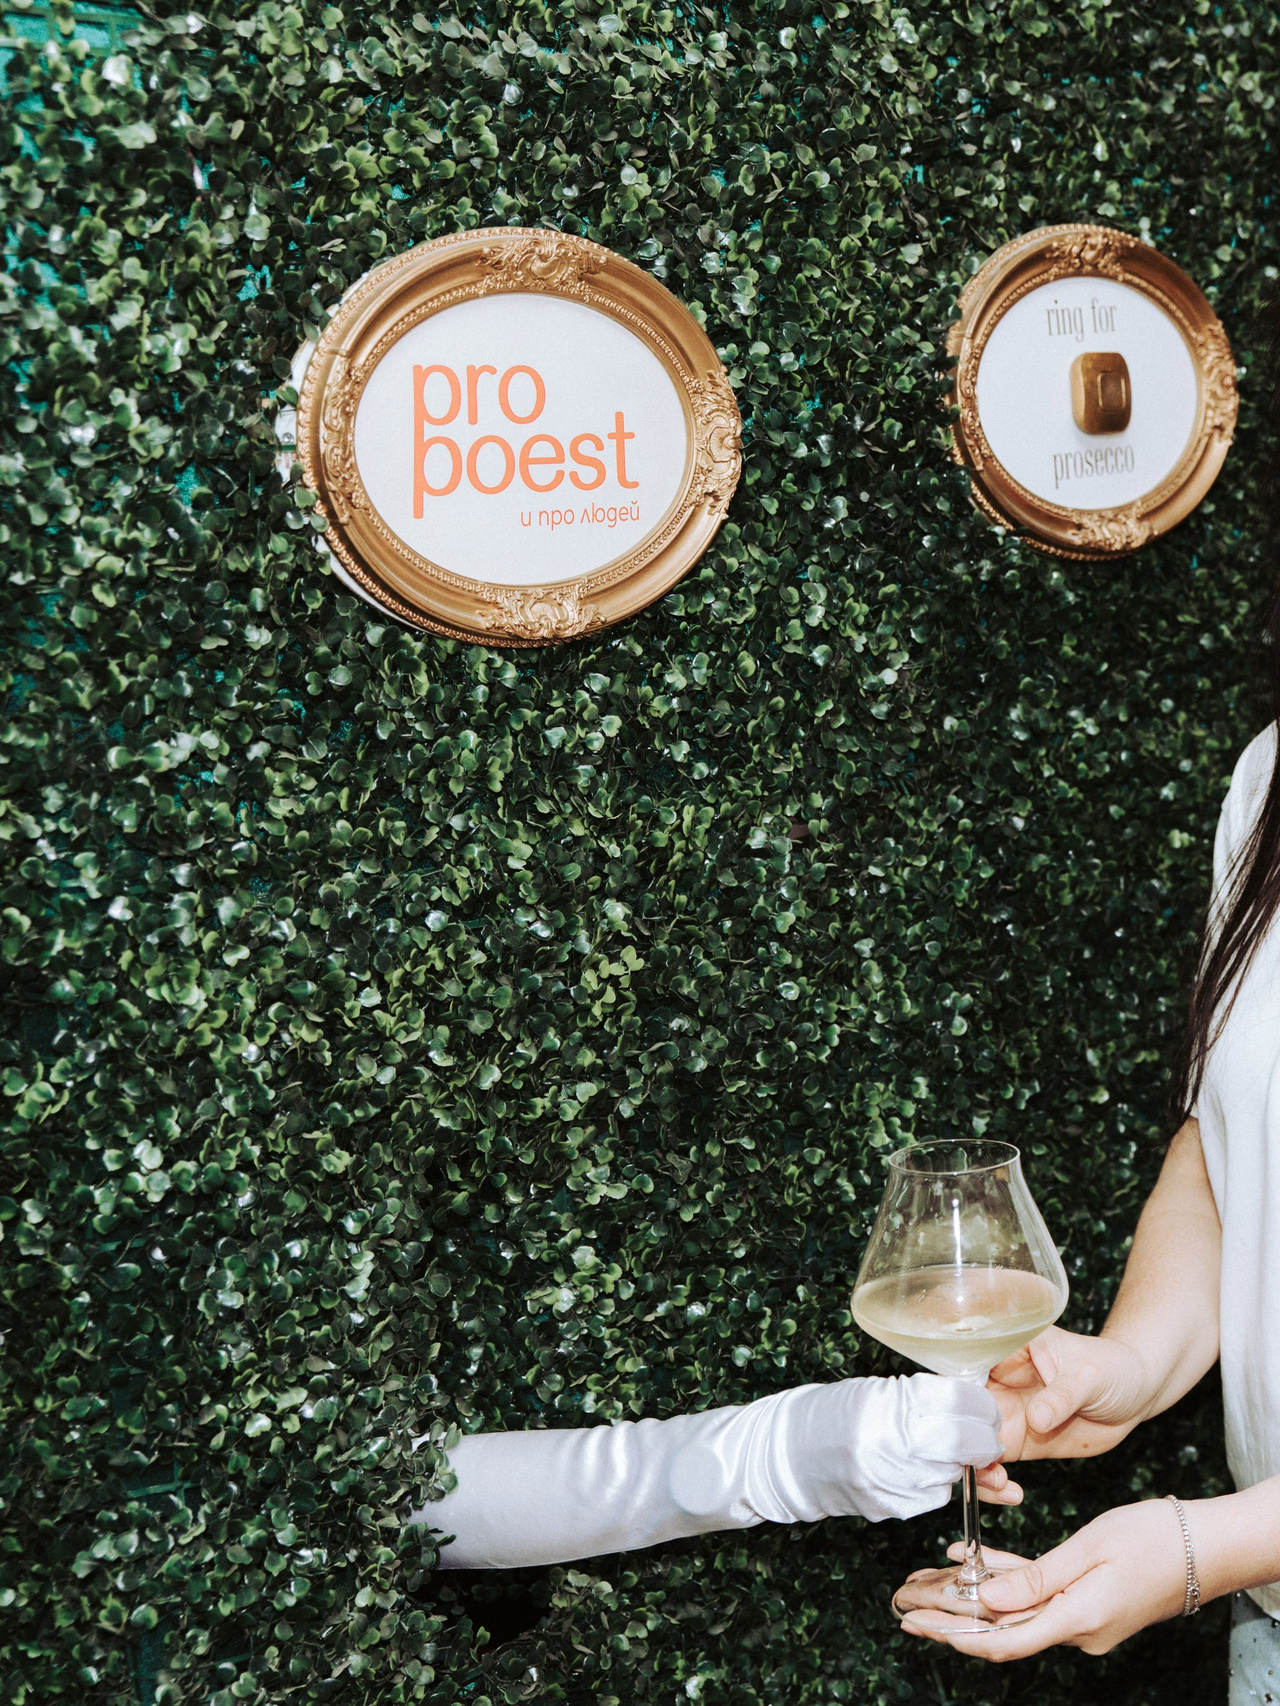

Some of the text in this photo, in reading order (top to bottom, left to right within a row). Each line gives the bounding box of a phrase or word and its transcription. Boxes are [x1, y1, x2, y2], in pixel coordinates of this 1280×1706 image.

[1046, 297, 1118, 343] ring for
[412, 364, 546, 426] pro
[412, 411, 640, 519] poest
[1053, 445, 1136, 490] prosecco
[539, 510, 575, 531] про
[580, 500, 640, 529] людей
